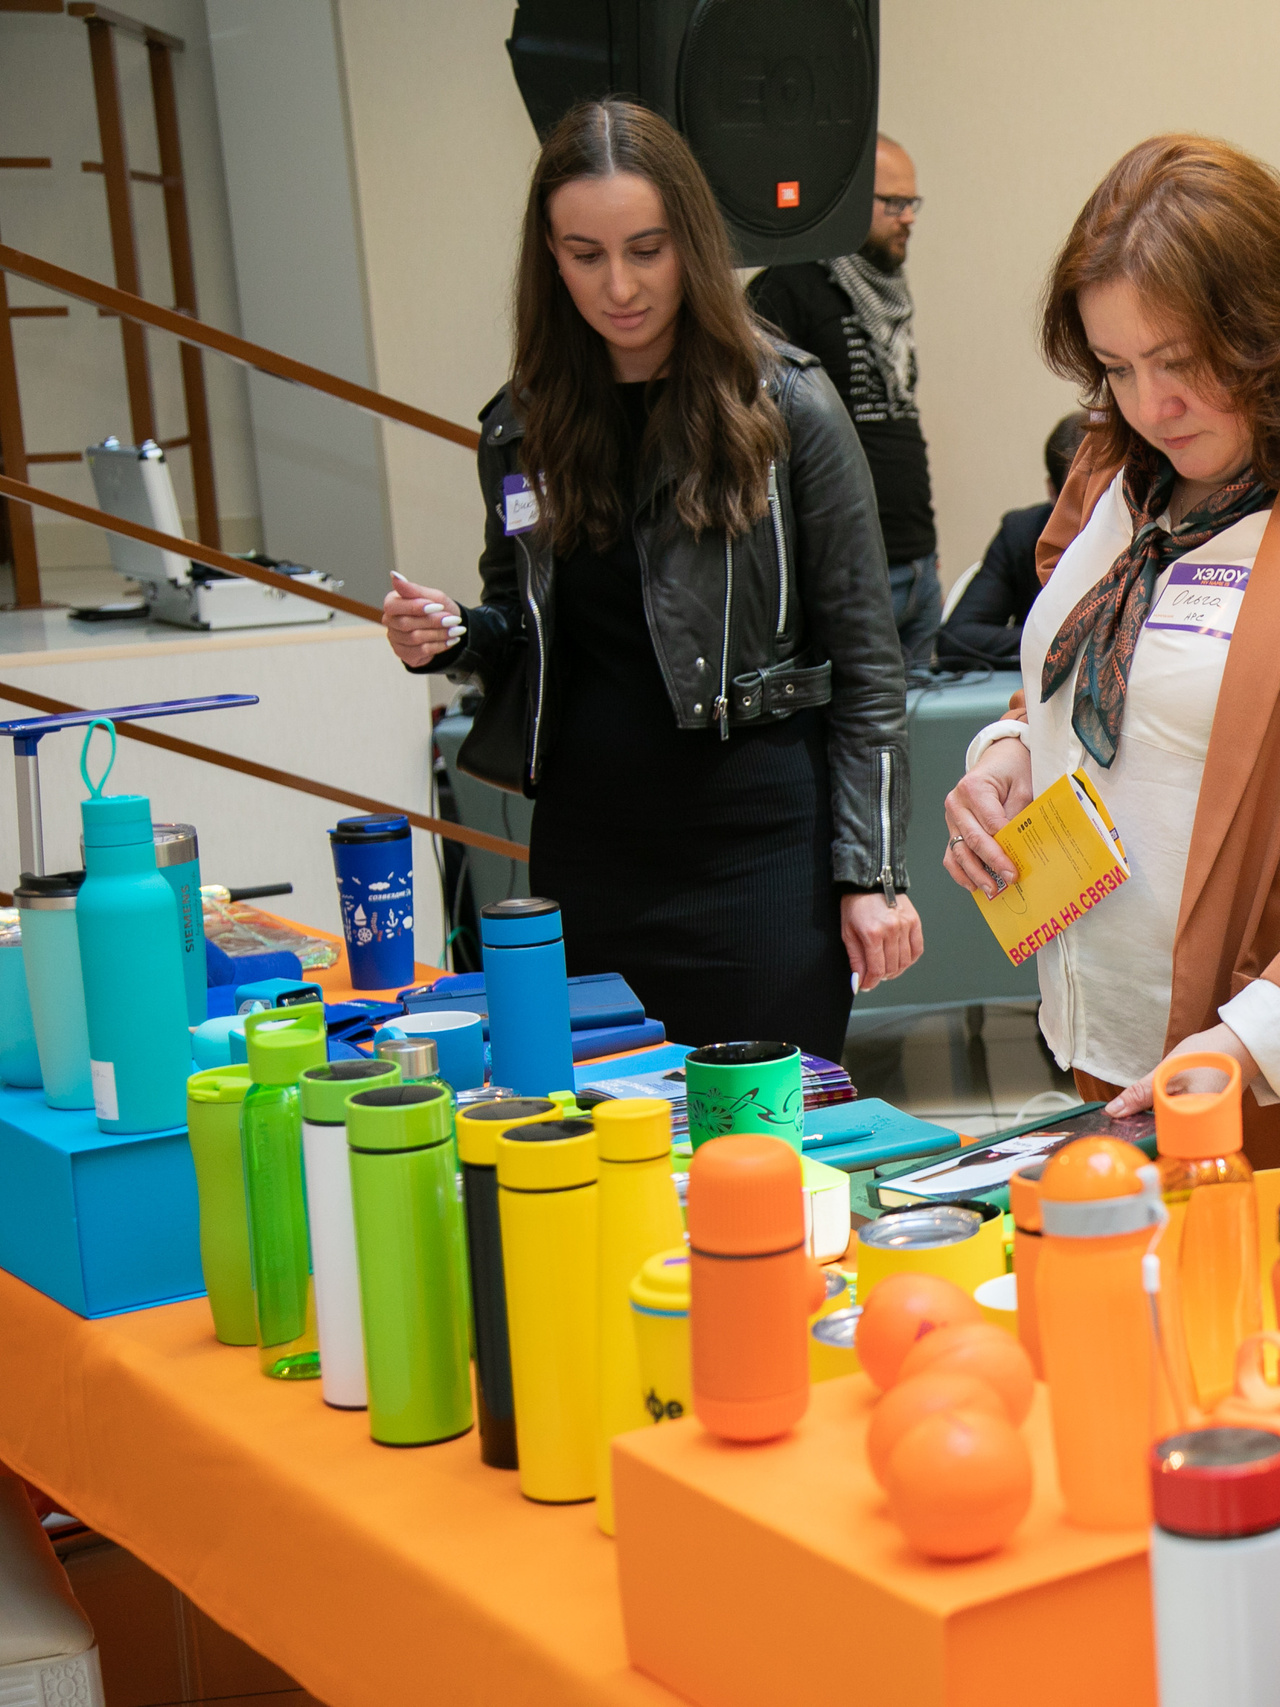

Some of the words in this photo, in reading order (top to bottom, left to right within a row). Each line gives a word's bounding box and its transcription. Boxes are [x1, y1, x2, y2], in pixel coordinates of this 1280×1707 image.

[1192, 567, 1249, 583] ХЭЛОУ
[181, 884, 195, 953] SIEMENS
[1008, 917, 1064, 966] ВСЕГДА
[1059, 901, 1083, 924] НА
[1078, 865, 1129, 910] СВЯЗИ
